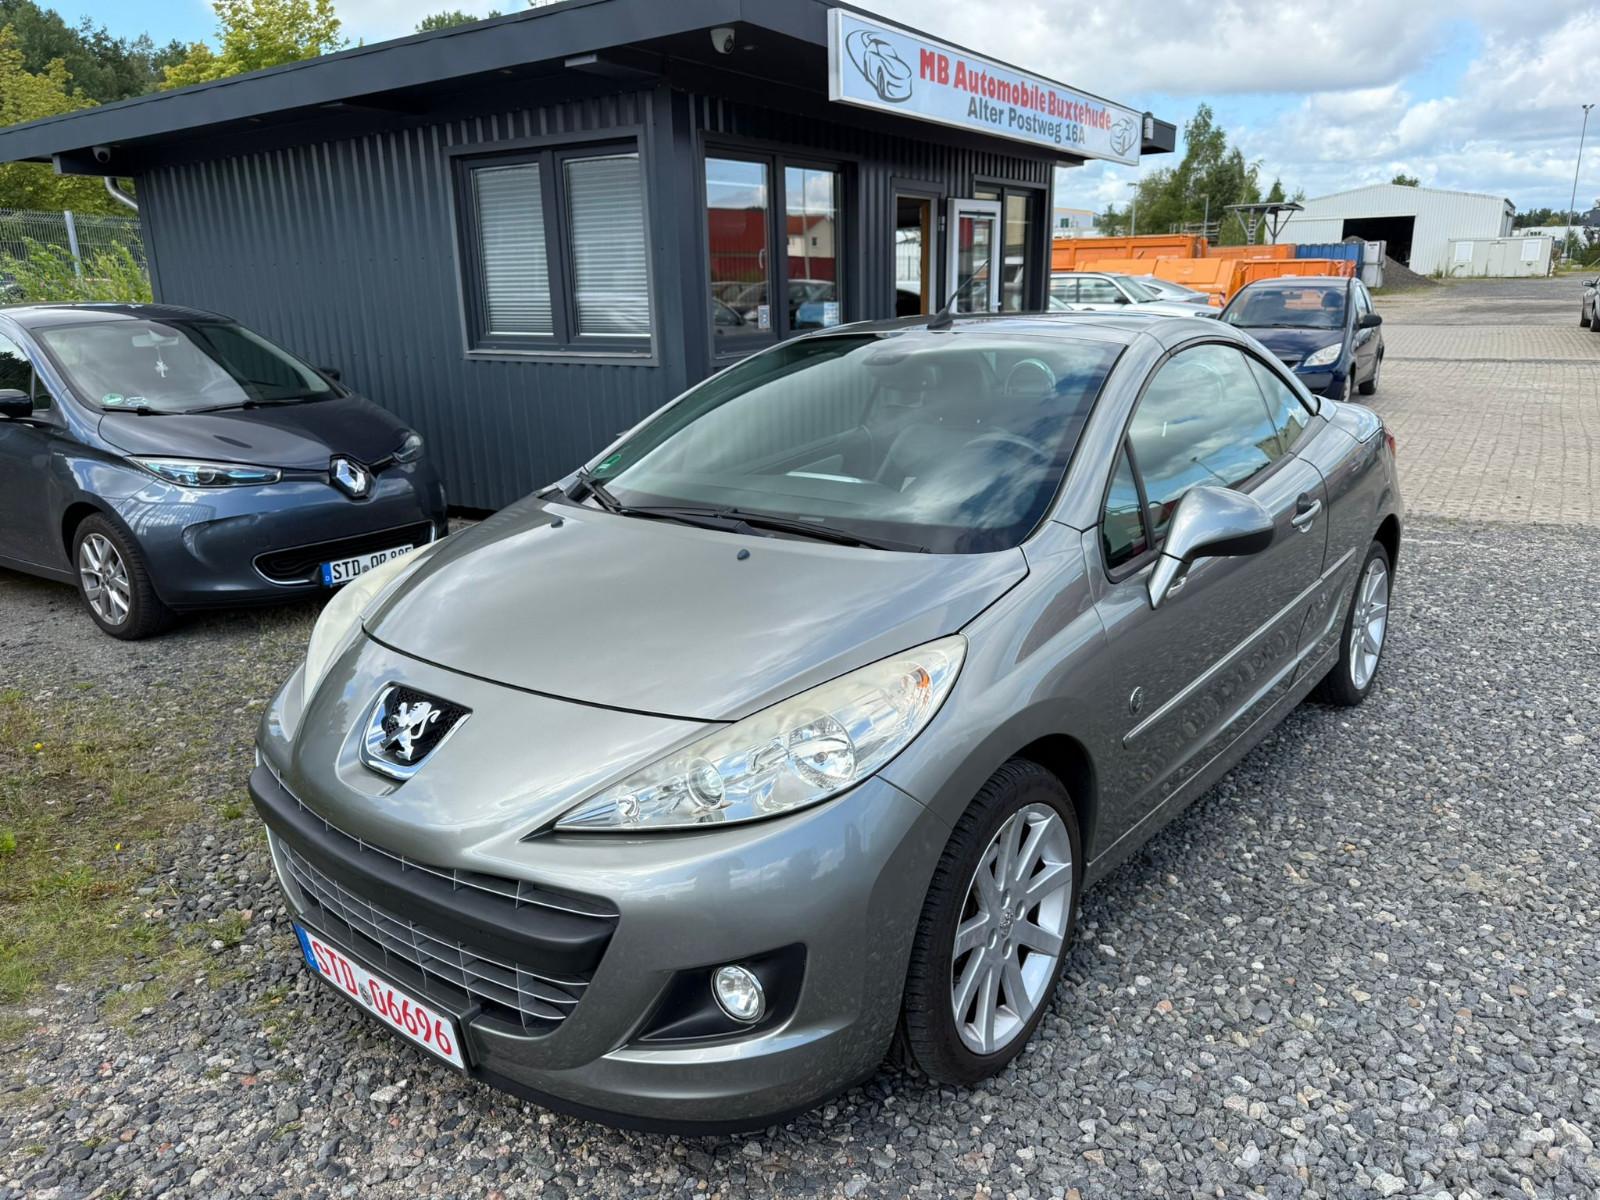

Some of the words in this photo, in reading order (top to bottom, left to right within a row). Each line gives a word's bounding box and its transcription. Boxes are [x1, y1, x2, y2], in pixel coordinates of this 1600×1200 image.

[920, 48, 949, 85] MB
[954, 60, 1046, 112] Automobile
[1048, 90, 1111, 130] Buxtehude
[968, 96, 1004, 124] Alter
[1008, 107, 1062, 144] Postweg
[1065, 123, 1085, 144] 16A
[333, 559, 361, 580] STD
[312, 941, 358, 995] STD
[369, 979, 452, 1055] 06696
